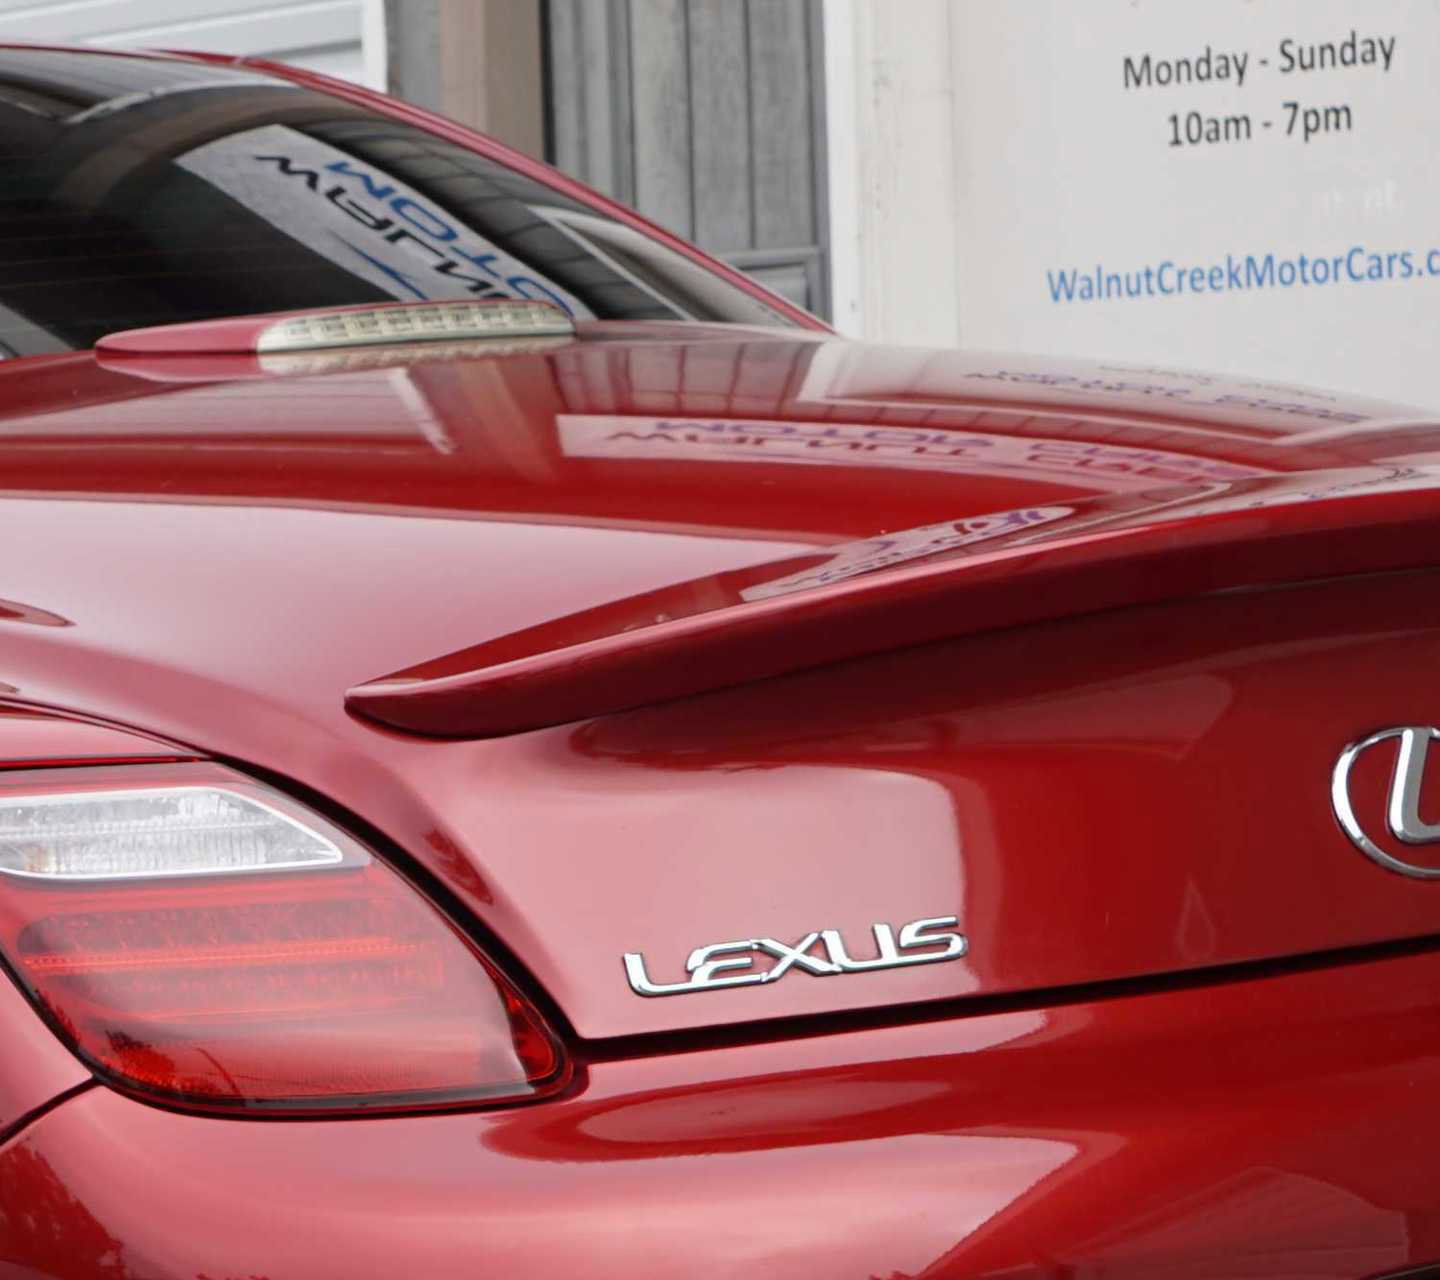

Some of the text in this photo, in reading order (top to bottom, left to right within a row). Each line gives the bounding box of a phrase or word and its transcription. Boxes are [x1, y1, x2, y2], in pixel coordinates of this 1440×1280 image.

[1122, 45, 1250, 90] Monday
[1278, 29, 1397, 75] Sunday
[1168, 110, 1253, 148] 10am
[1281, 100, 1354, 144] 7pm
[622, 915, 970, 998] LEXUS
